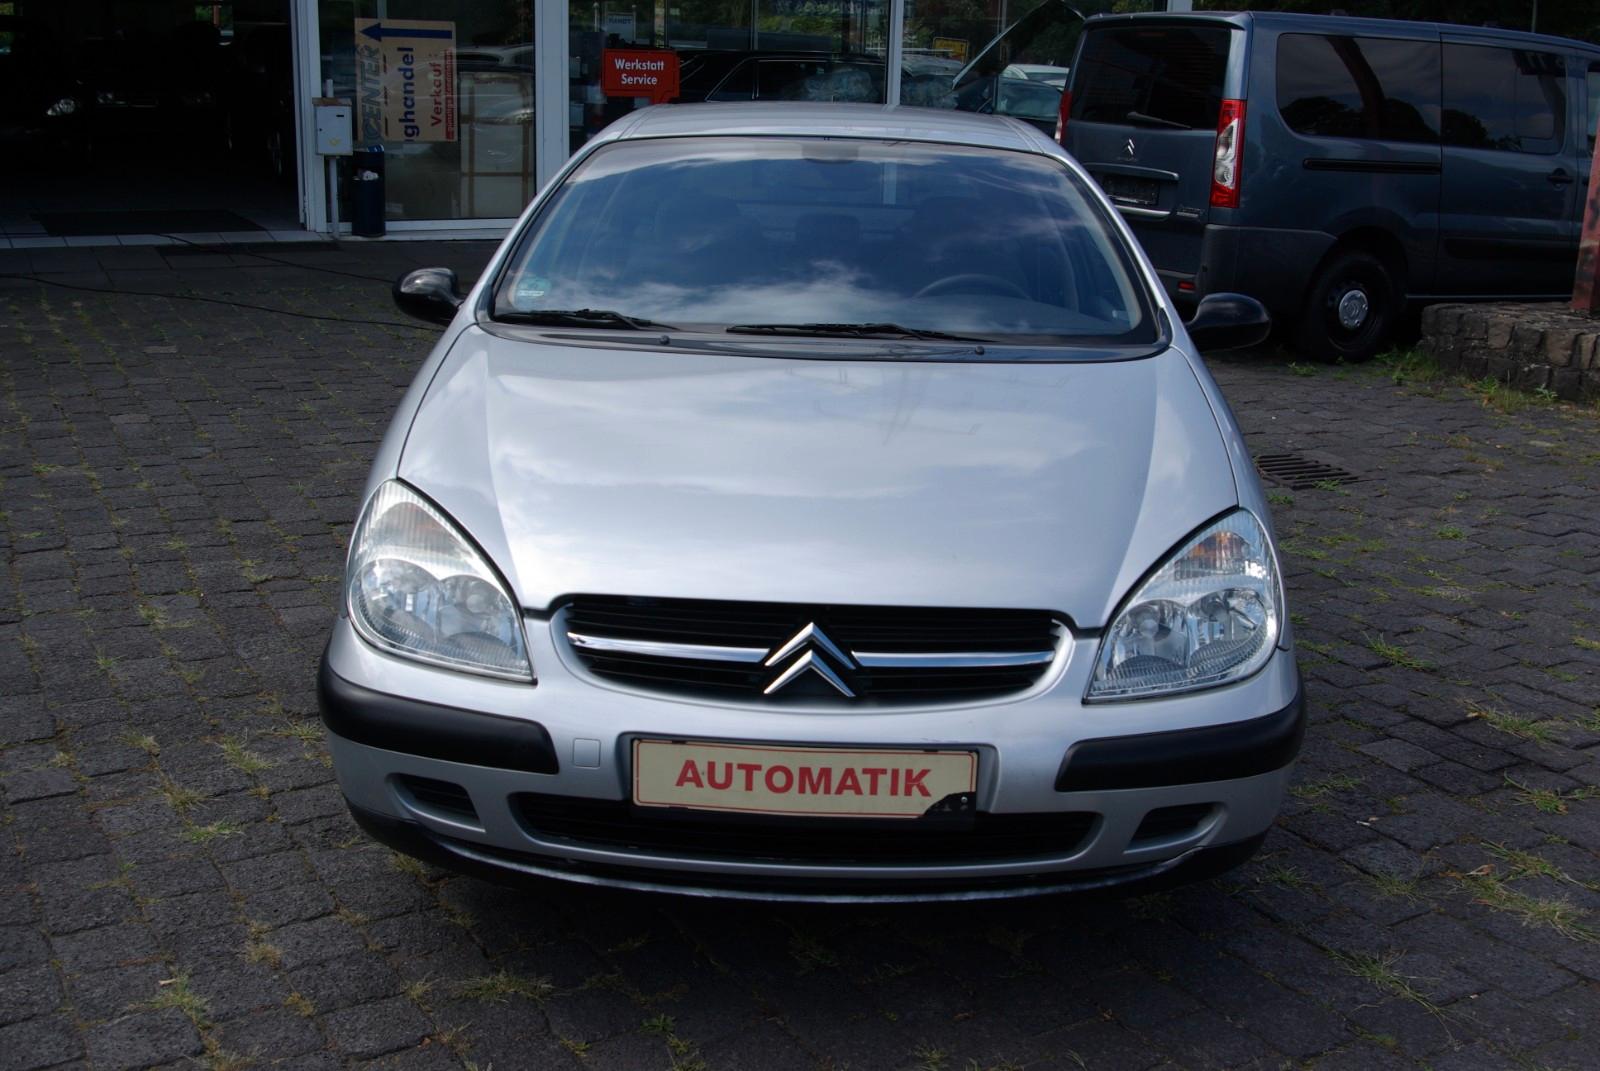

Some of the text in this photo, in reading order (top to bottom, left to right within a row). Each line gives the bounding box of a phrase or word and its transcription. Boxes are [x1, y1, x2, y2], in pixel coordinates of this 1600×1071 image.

[614, 58, 664, 71] Werkstatt
[621, 73, 658, 85] Service
[675, 759, 932, 798] AUTOMATIK
